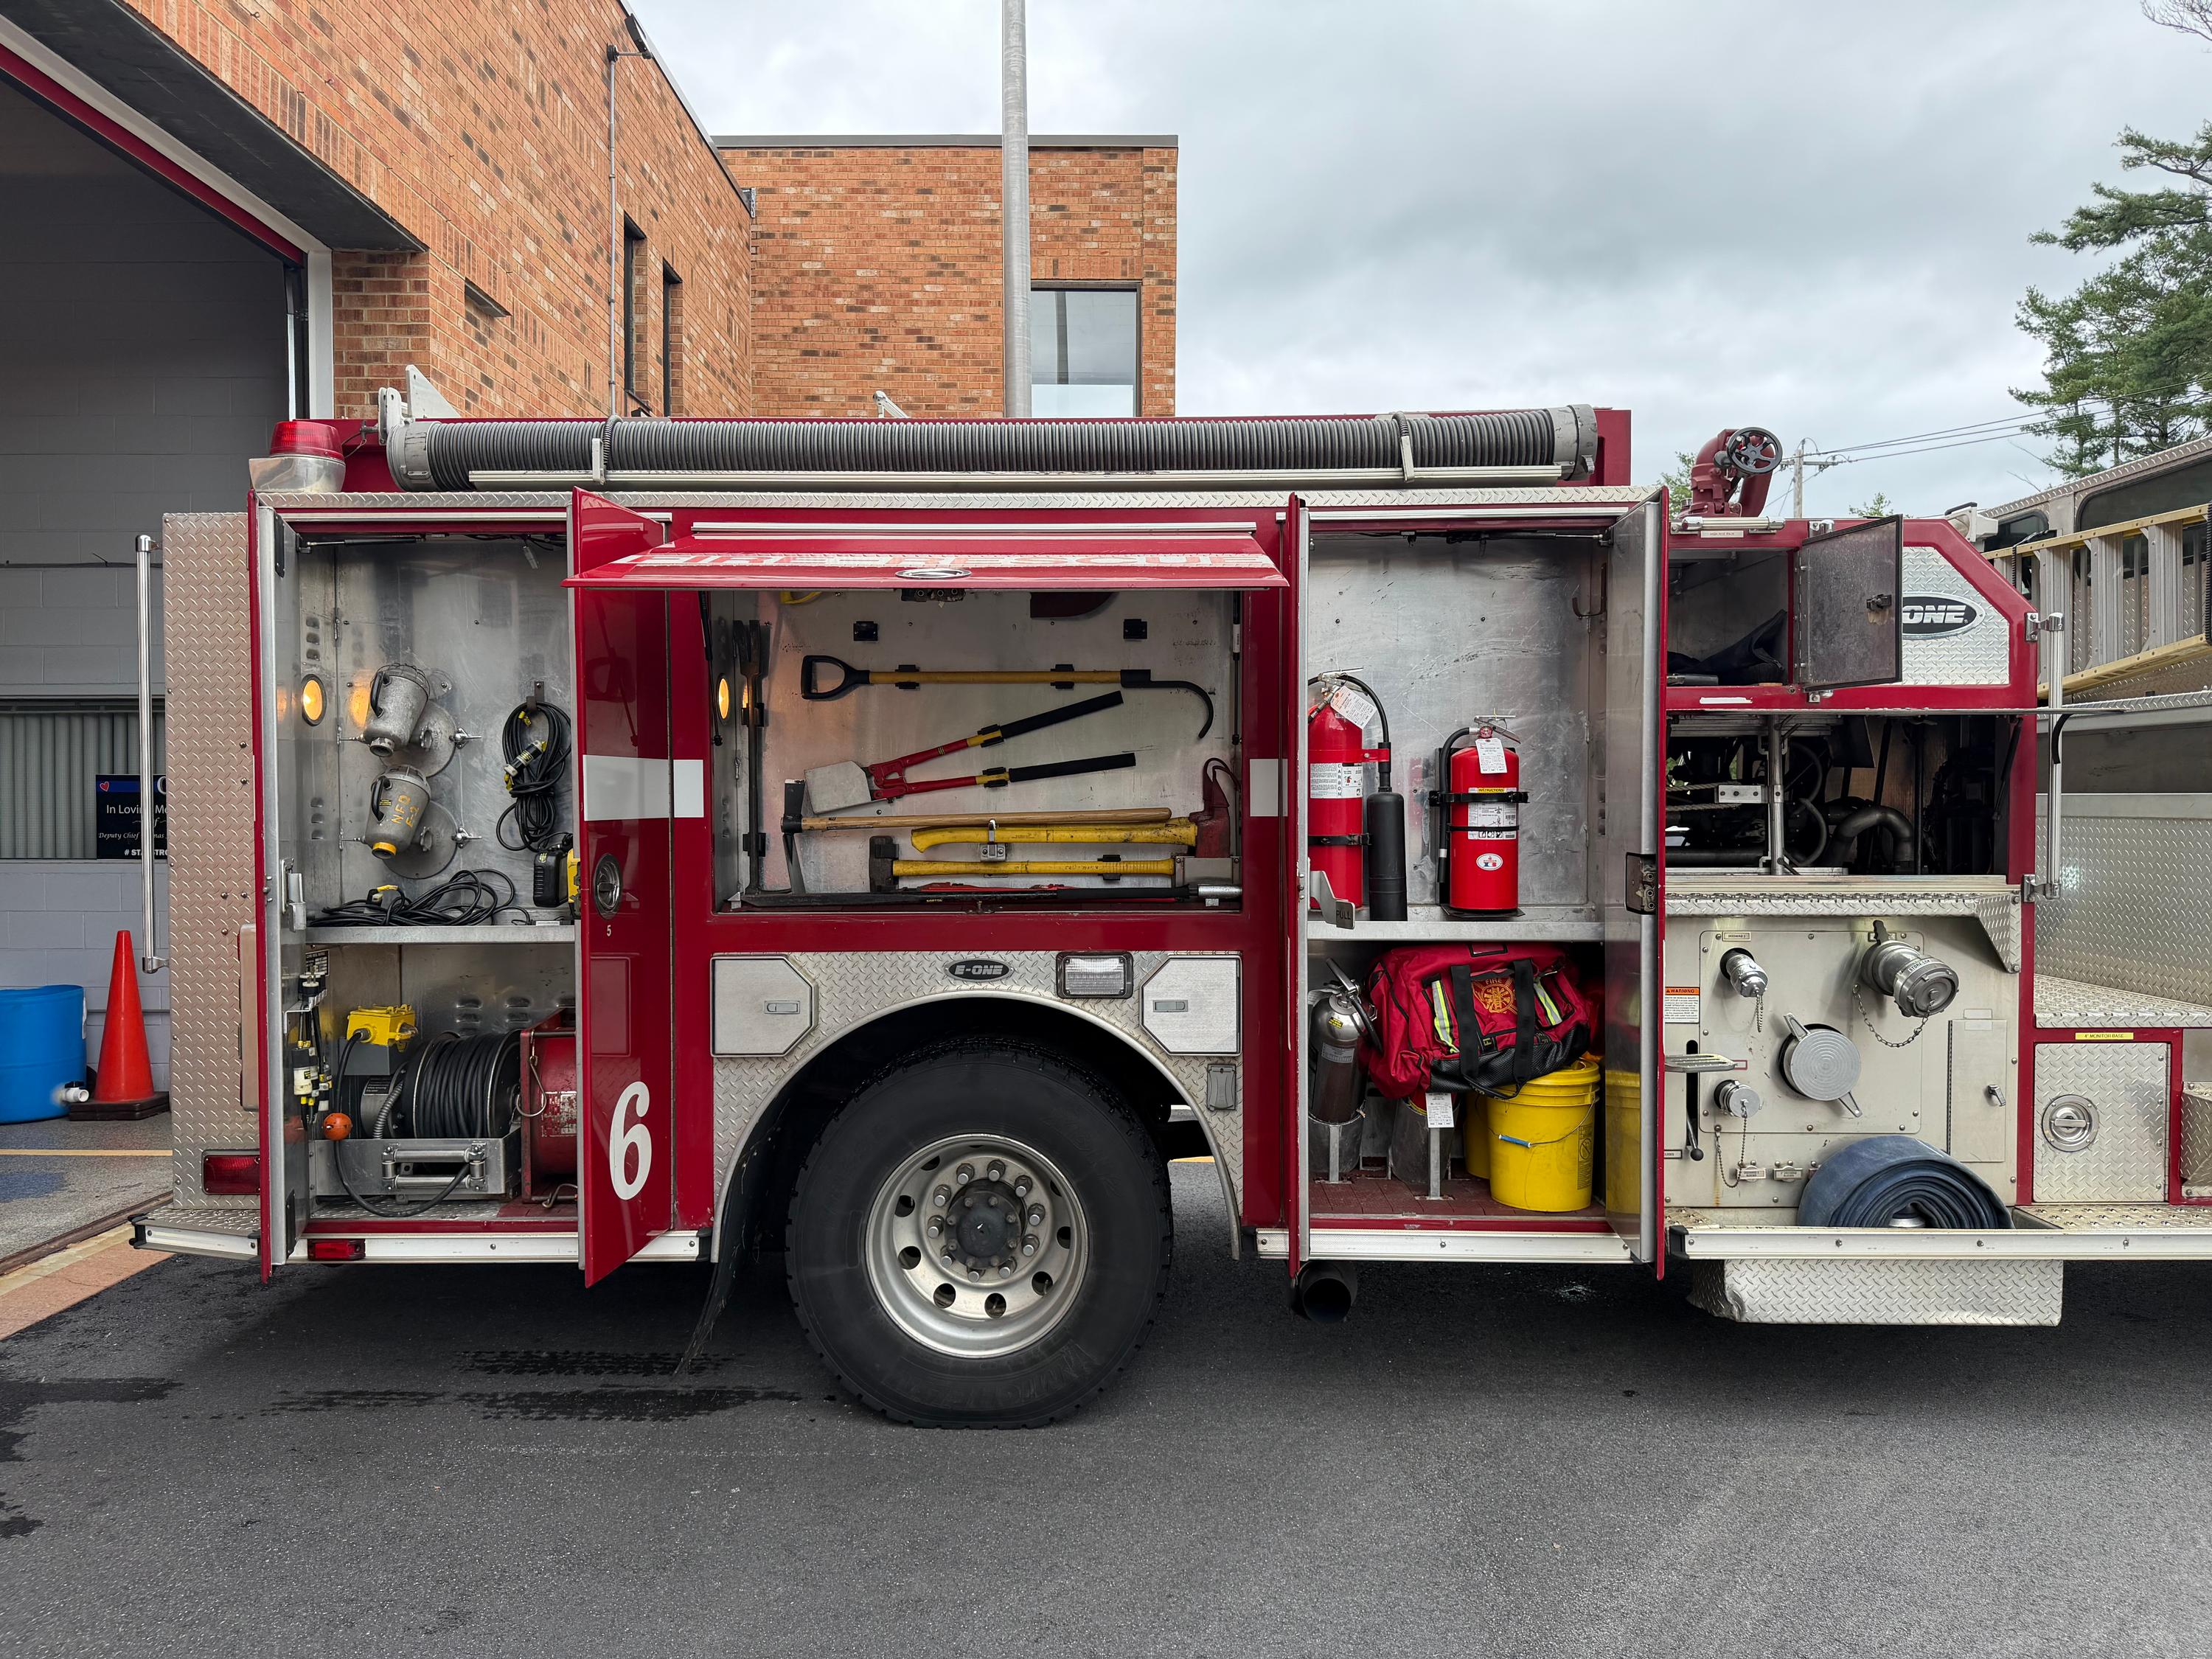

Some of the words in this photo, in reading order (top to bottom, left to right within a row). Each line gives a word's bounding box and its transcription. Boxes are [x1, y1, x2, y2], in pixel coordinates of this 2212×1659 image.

[1902, 605, 1966, 624] ONE
[106, 804, 116, 814] In
[119, 804, 142, 814] Lovi
[99, 832, 122, 841] Deputy
[123, 832, 140, 840] Chief
[606, 925, 612, 936] 5
[954, 965, 1004, 975] E-ONE
[609, 1081, 652, 1200] 6
